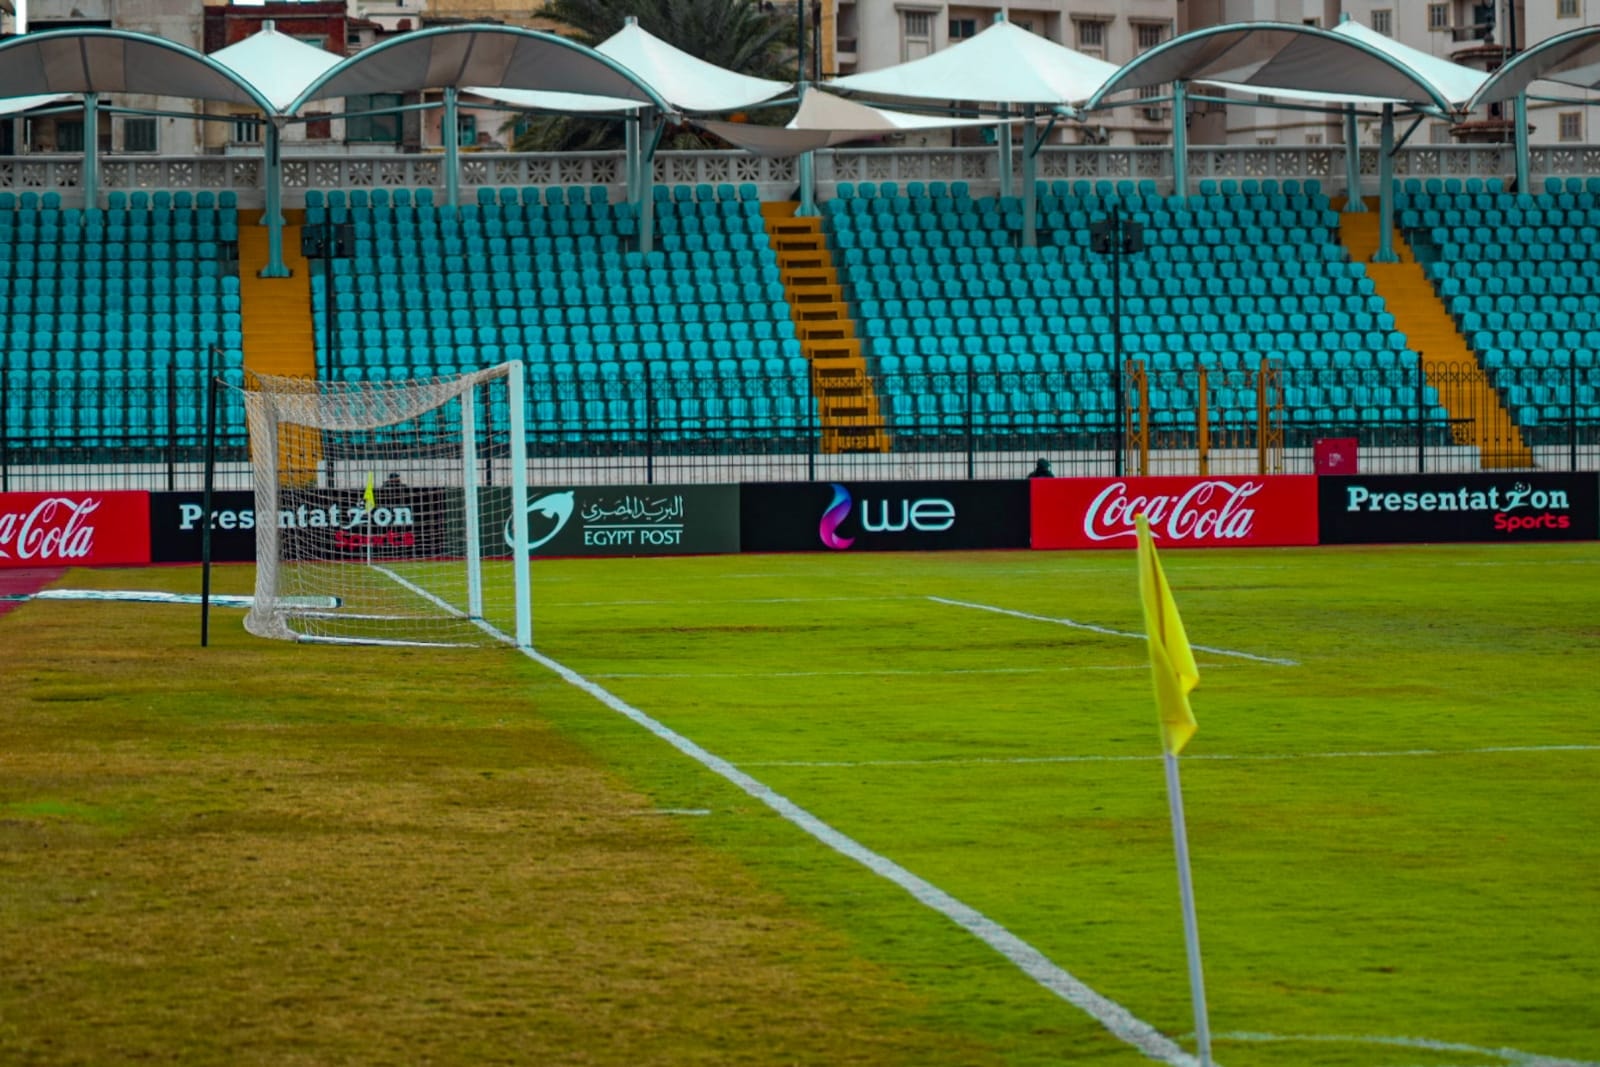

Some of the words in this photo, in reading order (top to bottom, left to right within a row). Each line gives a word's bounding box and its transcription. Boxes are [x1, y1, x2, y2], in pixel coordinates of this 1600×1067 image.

[179, 503, 413, 530] Presntation
[1084, 481, 1263, 541] Coca-Cola
[1494, 513, 1570, 532] Sports
[584, 530, 635, 546] EGYPT
[640, 529, 683, 545] POST
